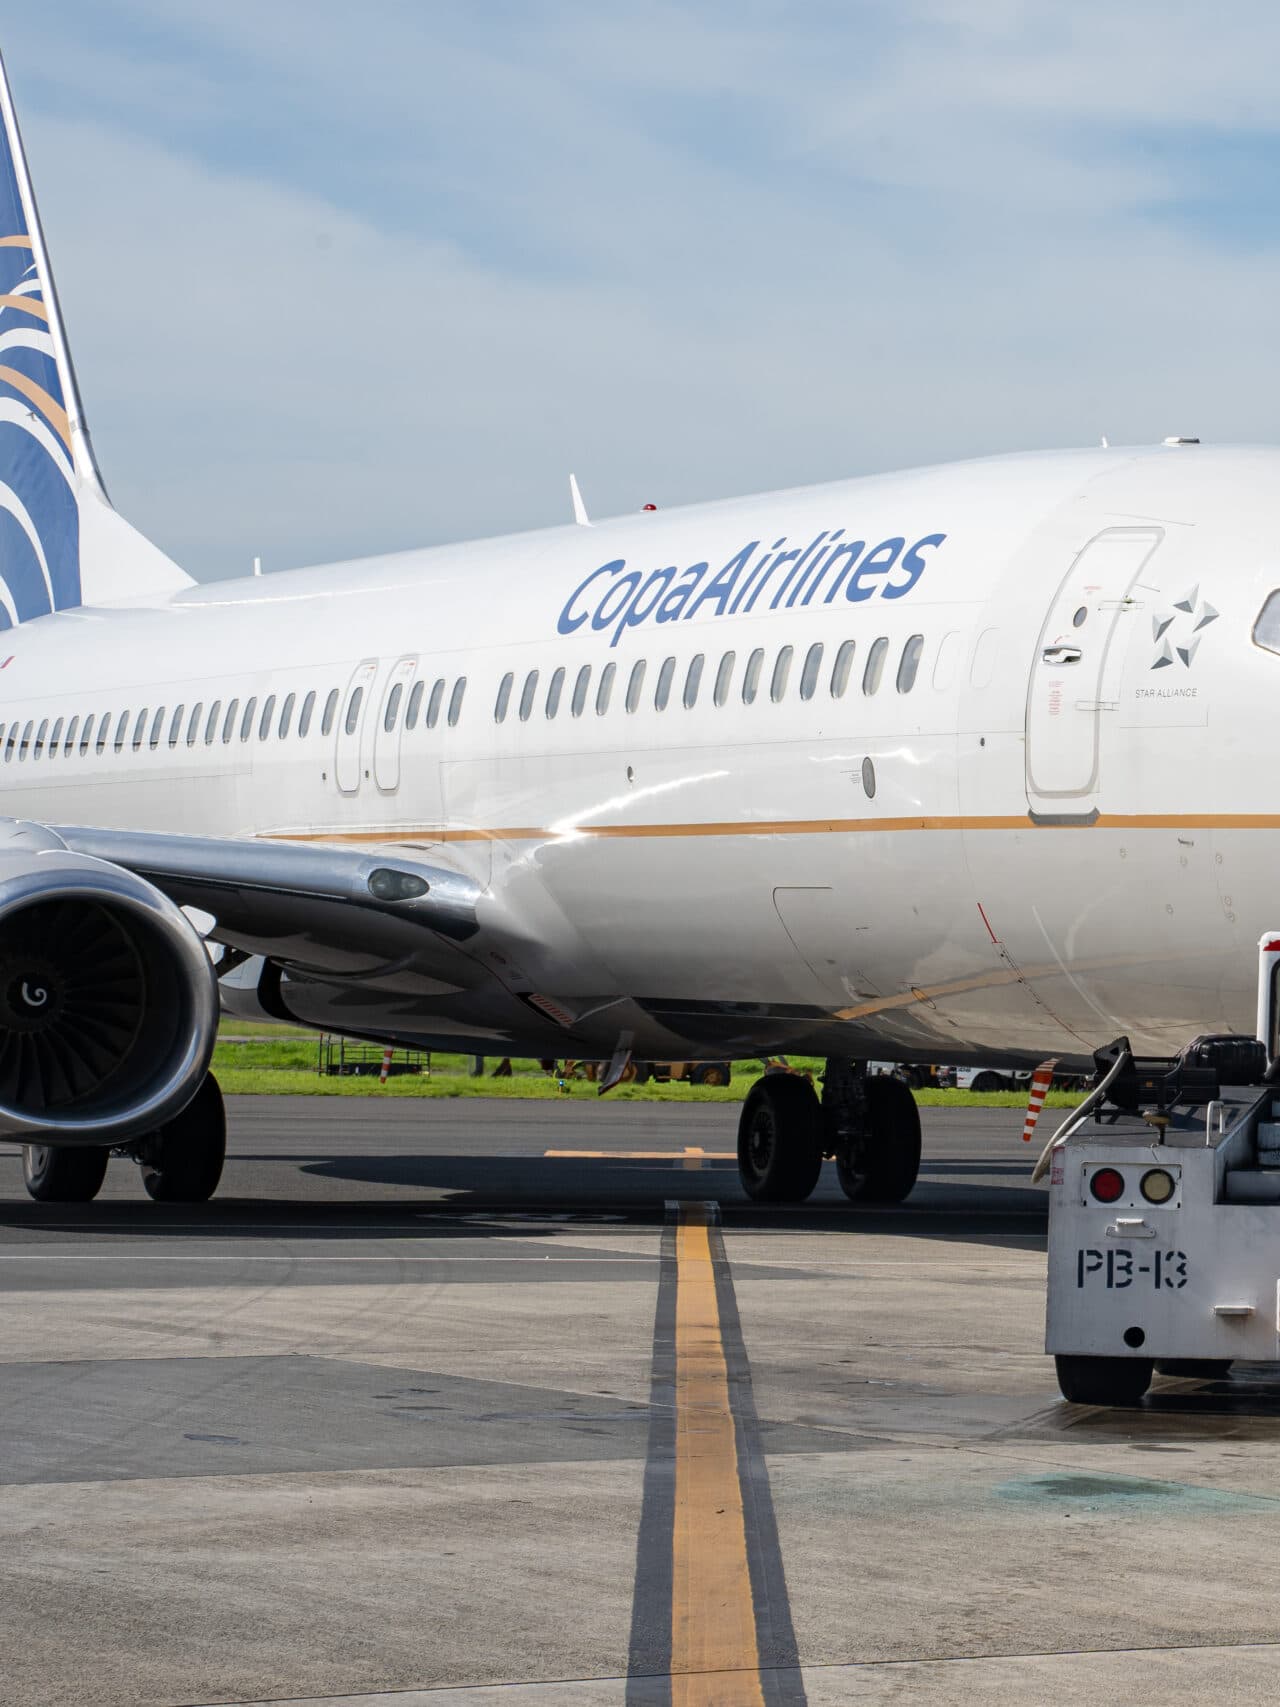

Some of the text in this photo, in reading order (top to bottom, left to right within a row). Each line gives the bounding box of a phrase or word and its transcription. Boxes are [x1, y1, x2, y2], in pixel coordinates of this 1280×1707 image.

[1135, 687, 1198, 699] STAR ALLIANCE
[1078, 1249, 1188, 1289] PB-13
